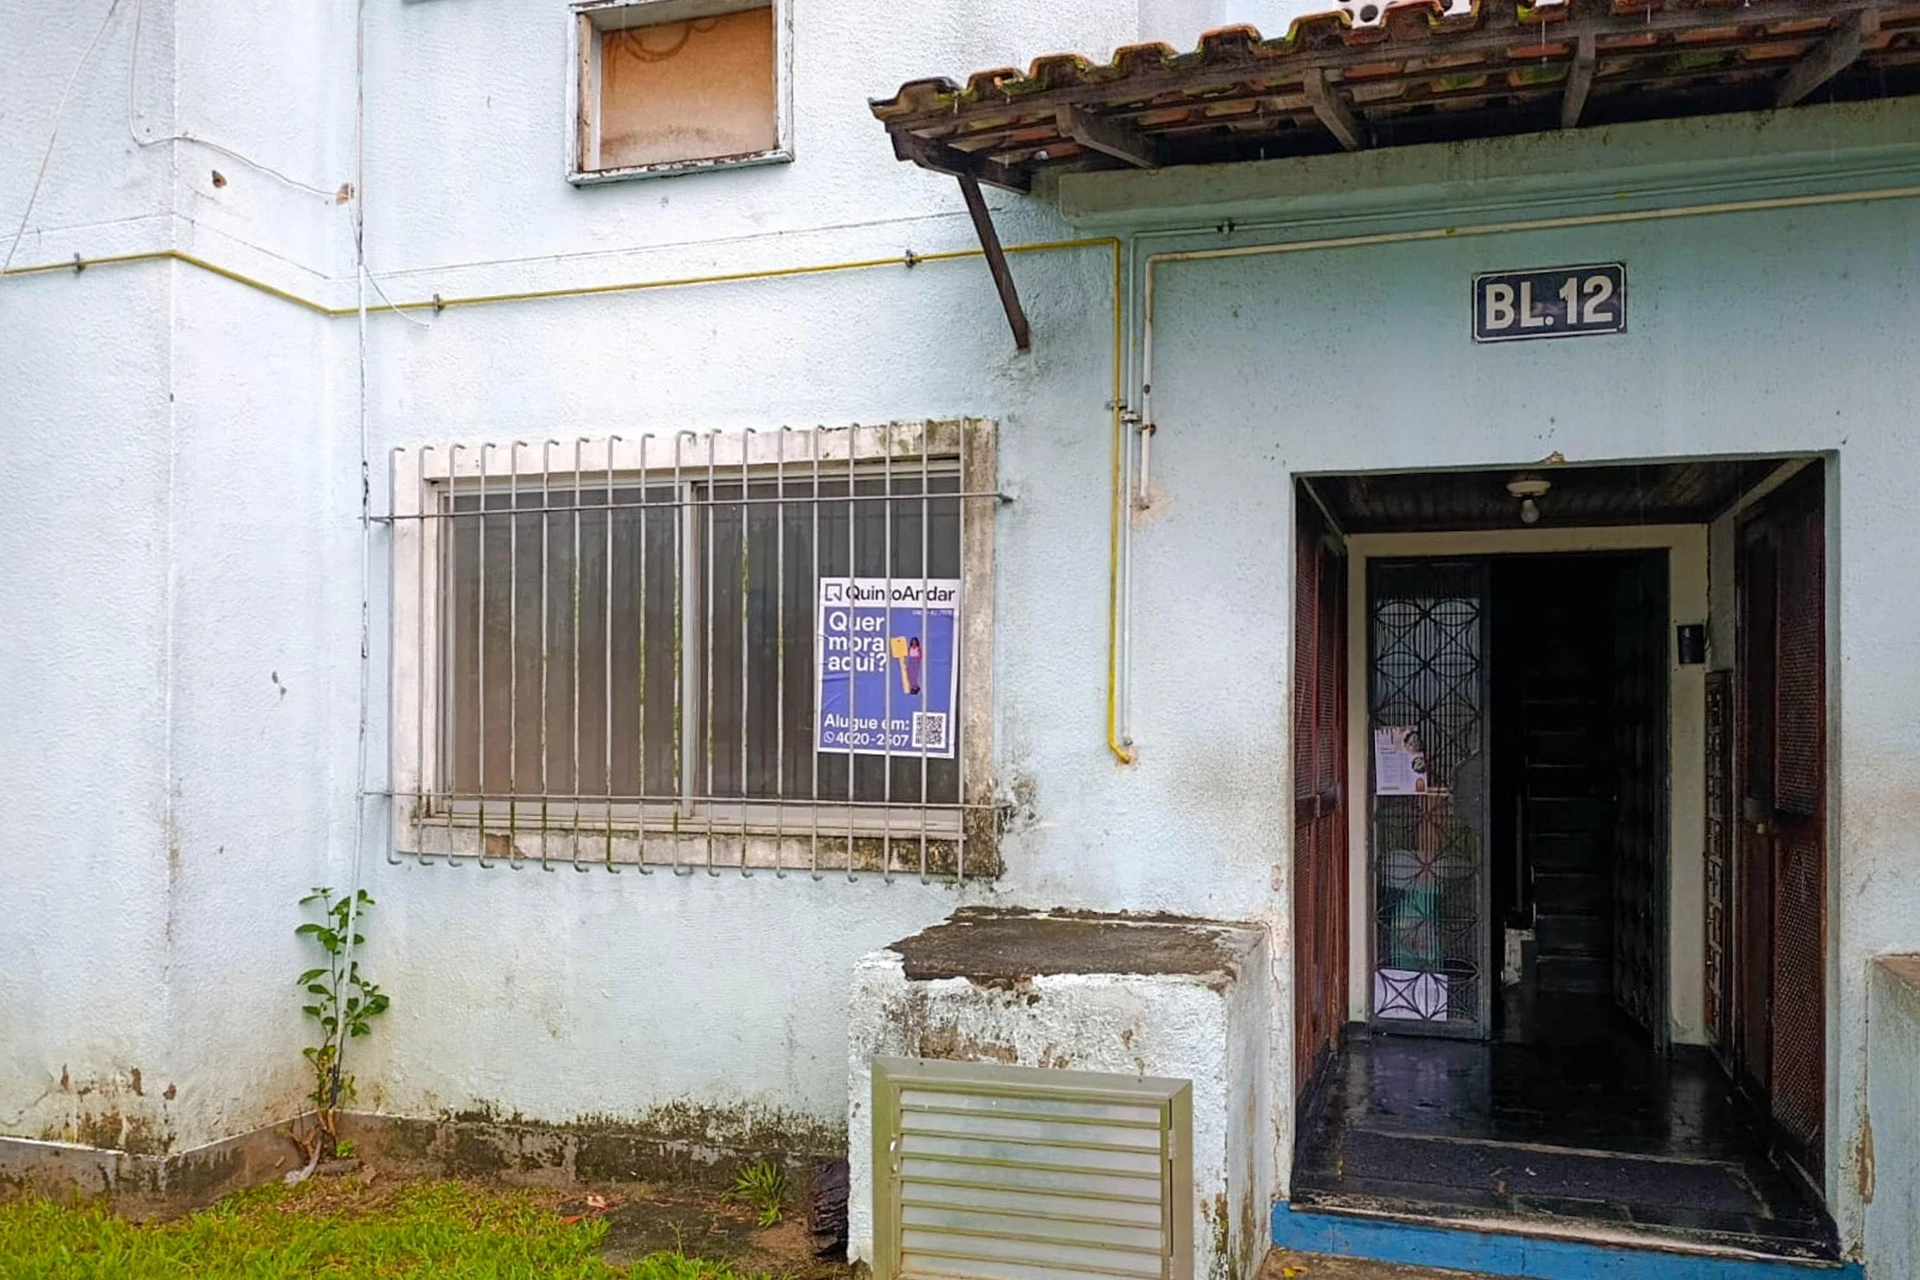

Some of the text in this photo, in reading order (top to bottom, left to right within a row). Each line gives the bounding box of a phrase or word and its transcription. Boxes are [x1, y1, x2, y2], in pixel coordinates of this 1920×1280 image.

[1485, 275, 1613, 329] BL.12
[846, 585, 955, 601] QuinoAndar
[829, 636, 884, 652] mora
[824, 713, 878, 731] Alugue
[836, 731, 909, 747] 4020-207
